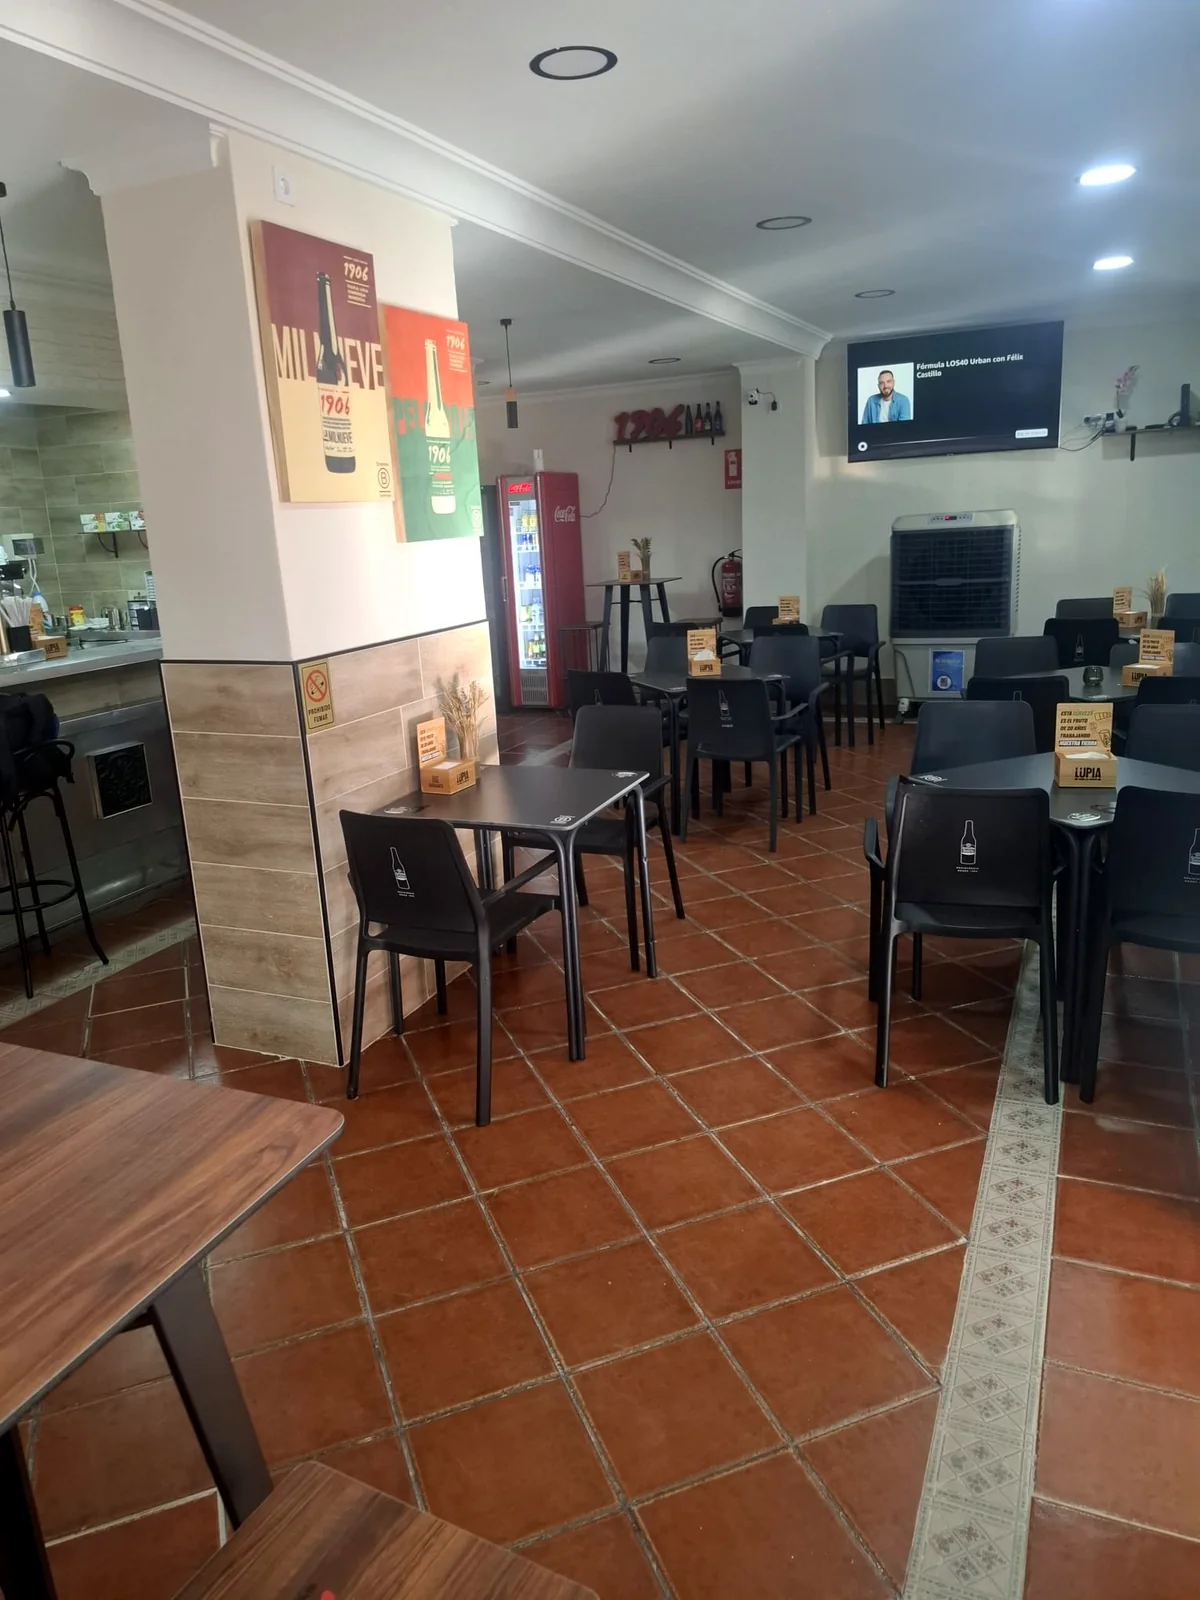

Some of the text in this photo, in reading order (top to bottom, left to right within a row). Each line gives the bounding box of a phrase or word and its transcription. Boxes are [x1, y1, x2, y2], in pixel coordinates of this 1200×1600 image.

[344, 262, 368, 281] 1906
[446, 335, 465, 350] 1906
[916, 361, 945, 370] Fórmula
[946, 359, 968, 368] LOS40
[970, 357, 991, 365] Urban
[1007, 353, 1023, 361] Félix
[916, 370, 942, 378] Castillo
[321, 394, 350, 415] 1906
[614, 403, 685, 441] 1906
[428, 445, 451, 464] 1906
[308, 704, 331, 715] PROHIBIDO
[313, 713, 328, 723] FUMAR
[1074, 767, 1101, 778] LUPIA
